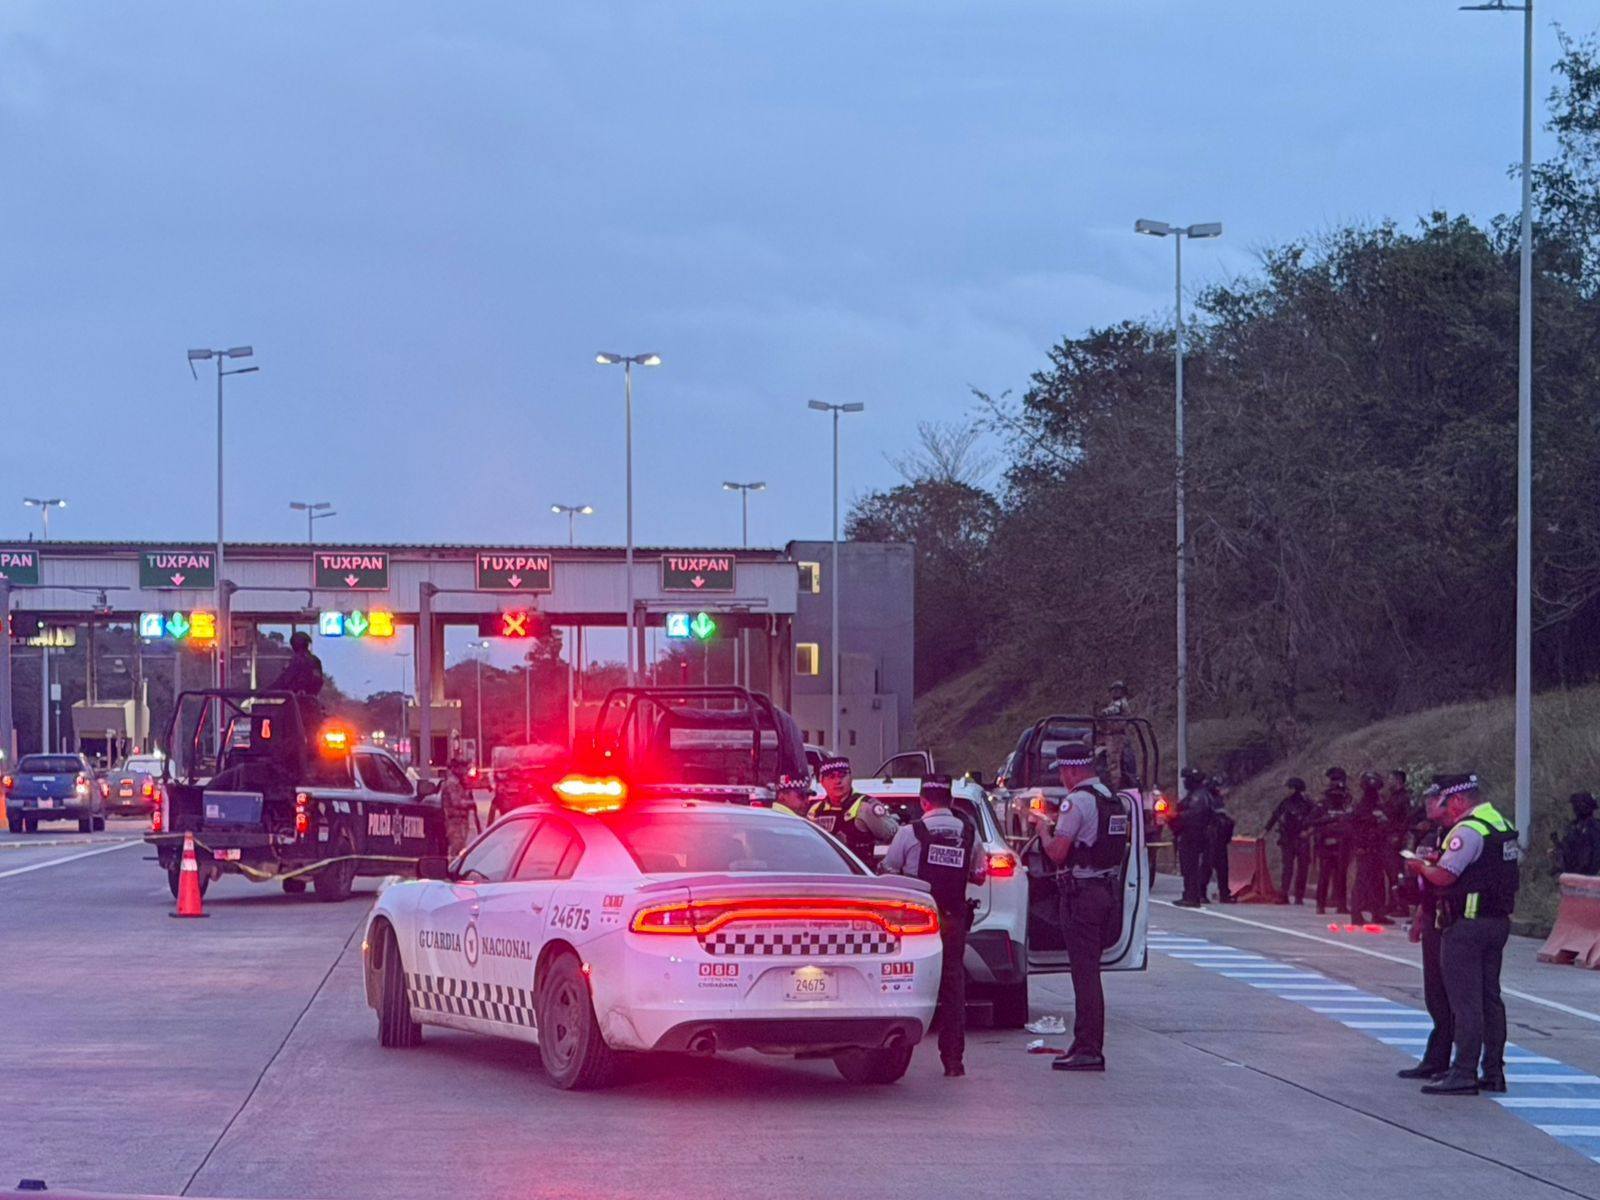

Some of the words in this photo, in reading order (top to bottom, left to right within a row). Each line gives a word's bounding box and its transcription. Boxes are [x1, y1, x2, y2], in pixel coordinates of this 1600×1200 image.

[0, 554, 33, 567] PAN
[147, 555, 210, 569] TUXPAN
[321, 556, 383, 570] TUXPAN
[481, 557, 548, 571] TUXPAN
[668, 557, 729, 571] TUXPAN
[550, 905, 591, 931] 24675
[419, 929, 462, 952] GUARDIA
[481, 936, 533, 960] NACIONAL
[700, 963, 738, 976] 088
[881, 962, 913, 975] 911
[796, 978, 826, 991] 24675
